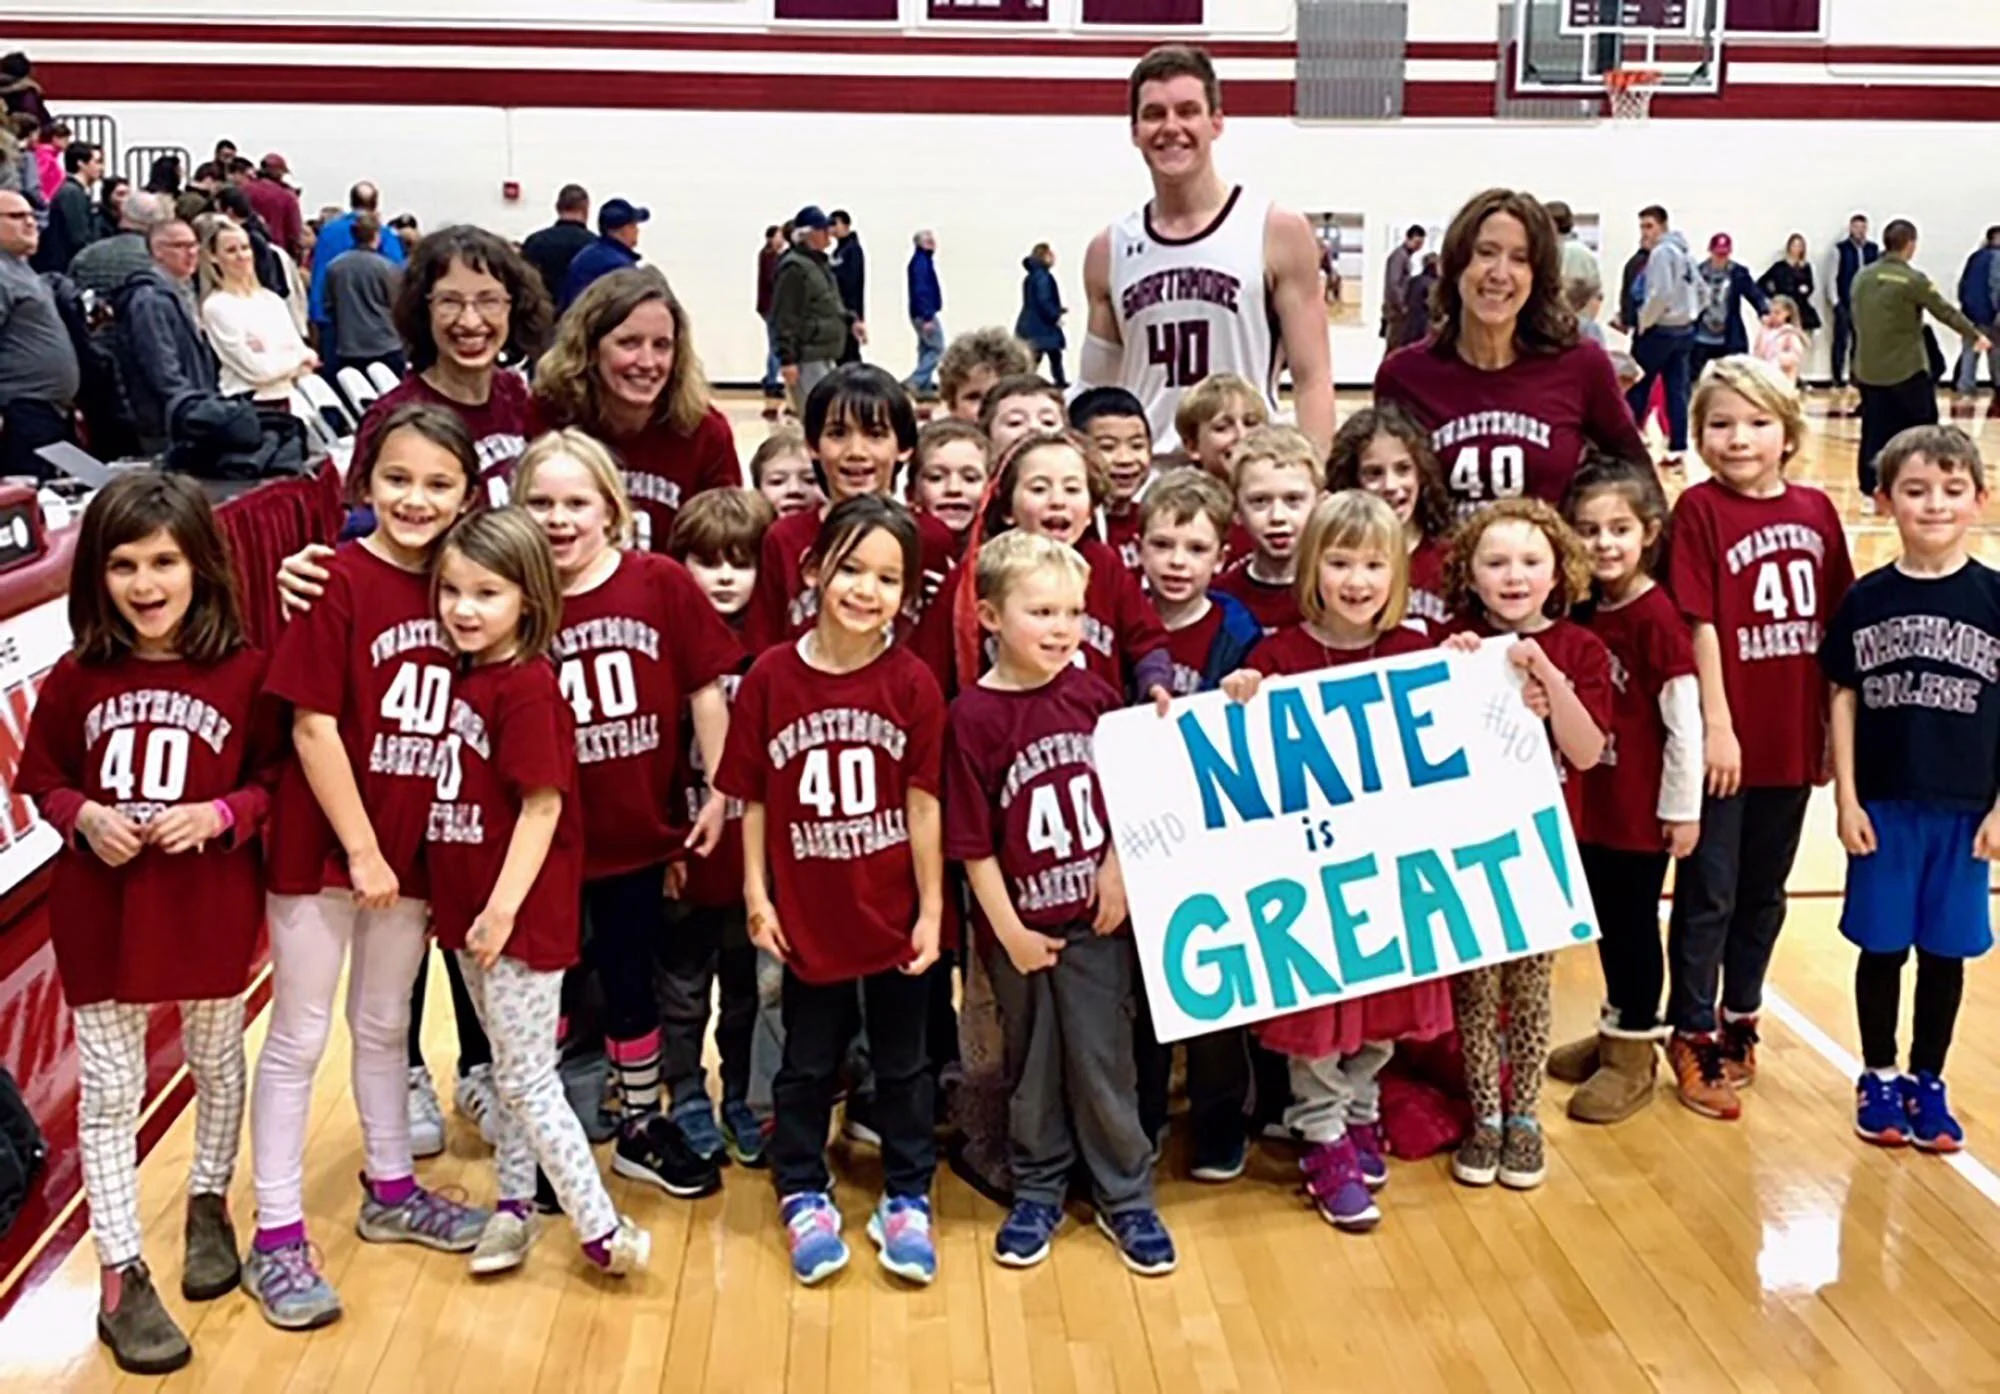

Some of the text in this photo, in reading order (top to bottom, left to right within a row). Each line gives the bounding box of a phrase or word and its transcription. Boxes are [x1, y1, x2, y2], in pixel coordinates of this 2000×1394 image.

[1146, 319, 1209, 388] 40
[1450, 444, 1524, 498] 40
[1753, 559, 1816, 620] 40
[381, 661, 451, 735] 40
[558, 650, 637, 723] 40
[1862, 670, 1981, 714] COLLEGE
[768, 708, 907, 769] SWARTHMORE
[1177, 661, 1469, 830] NATE
[1480, 692, 1541, 765] #40
[101, 727, 190, 802] 40
[436, 733, 462, 800] 0
[799, 746, 876, 817] 40
[790, 808, 908, 860] BASKETBALL
[1027, 773, 1105, 859] 40
[1121, 811, 1186, 860] #40
[1301, 815, 1335, 852] is
[1162, 805, 1592, 1021] GREAT!
